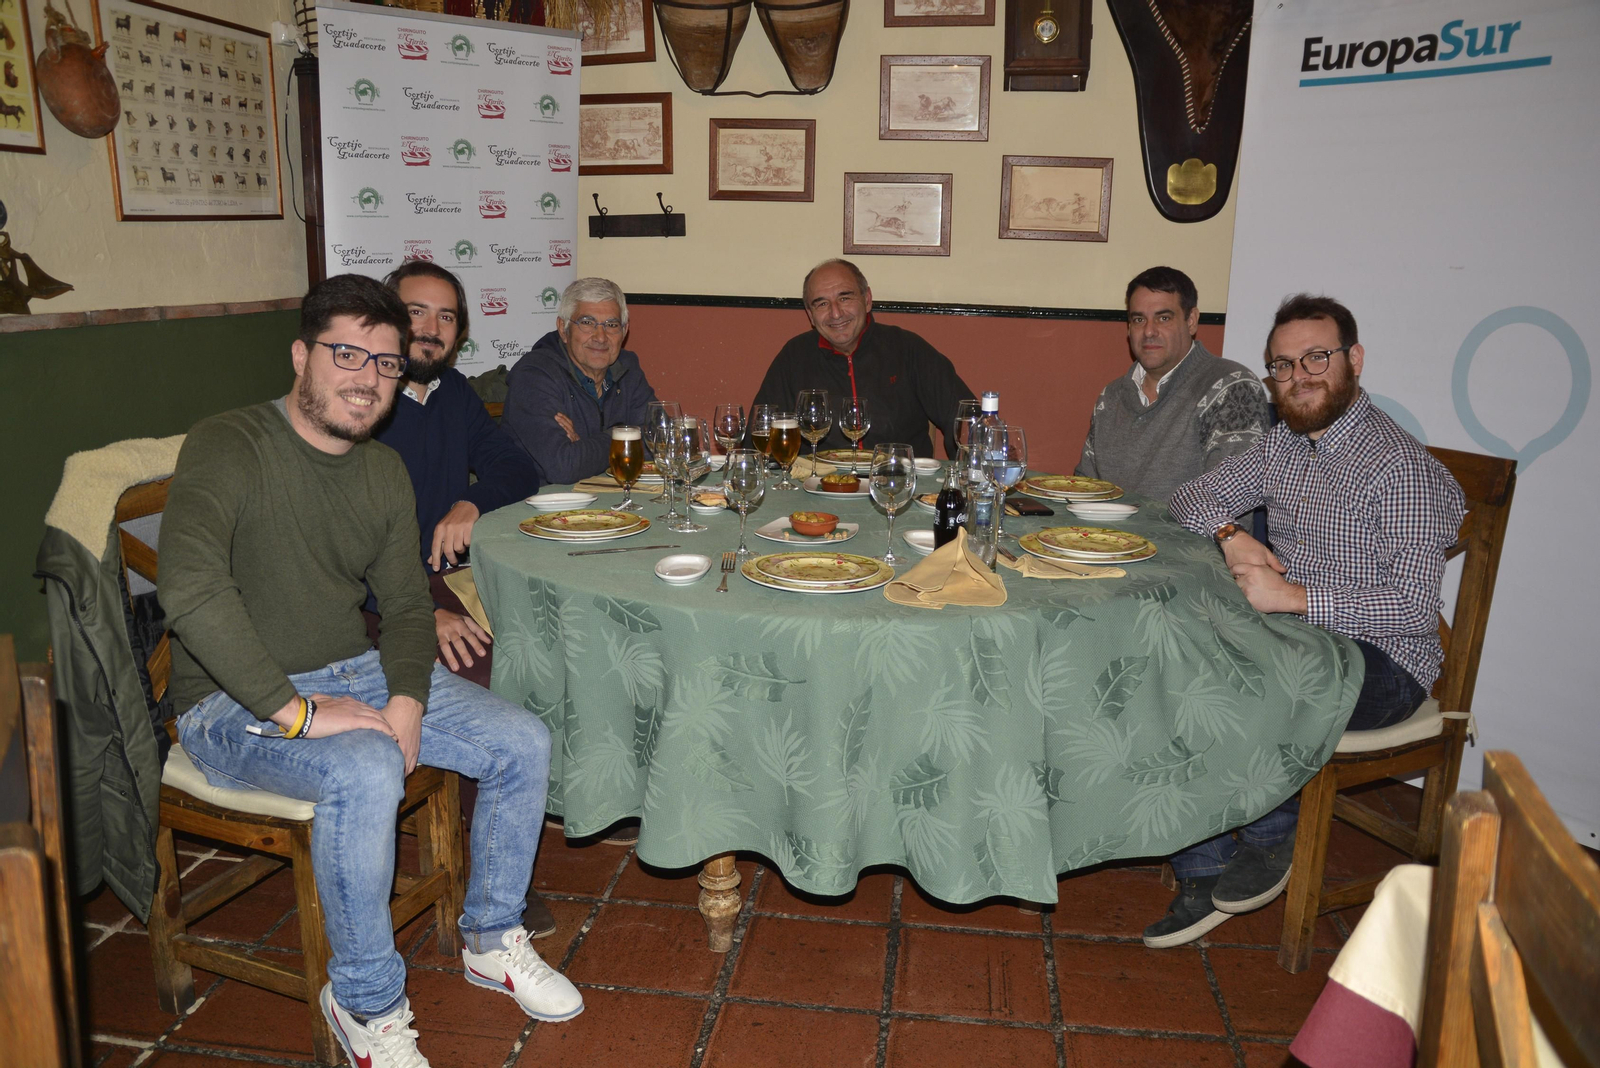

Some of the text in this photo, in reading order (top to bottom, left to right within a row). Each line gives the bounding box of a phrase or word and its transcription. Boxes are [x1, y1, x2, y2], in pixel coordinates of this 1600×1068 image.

[323, 23, 357, 40] Cortijo
[397, 27, 426, 35] CHIRINGUITO
[332, 35, 386, 51] Guadacorte
[486, 42, 516, 57] Cortijo
[1301, 19, 1522, 74] EuropaSur
[494, 53, 540, 67] Guadacorte
[402, 87, 434, 102] Cortijo
[411, 97, 460, 111] Guadacorte
[327, 136, 362, 151] Cortijo
[336, 147, 390, 160] Guadacorte
[488, 144, 517, 158] Cortijo
[495, 155, 542, 166] Guadacorte
[405, 192, 437, 206] Cortijo
[414, 202, 462, 214] Guadacorte
[330, 244, 366, 258] Cortijo
[489, 243, 518, 256] Cortijo
[340, 254, 393, 266] Guadacorte
[497, 253, 542, 264] Guadacorte
[490, 339, 519, 350] Cortijo
